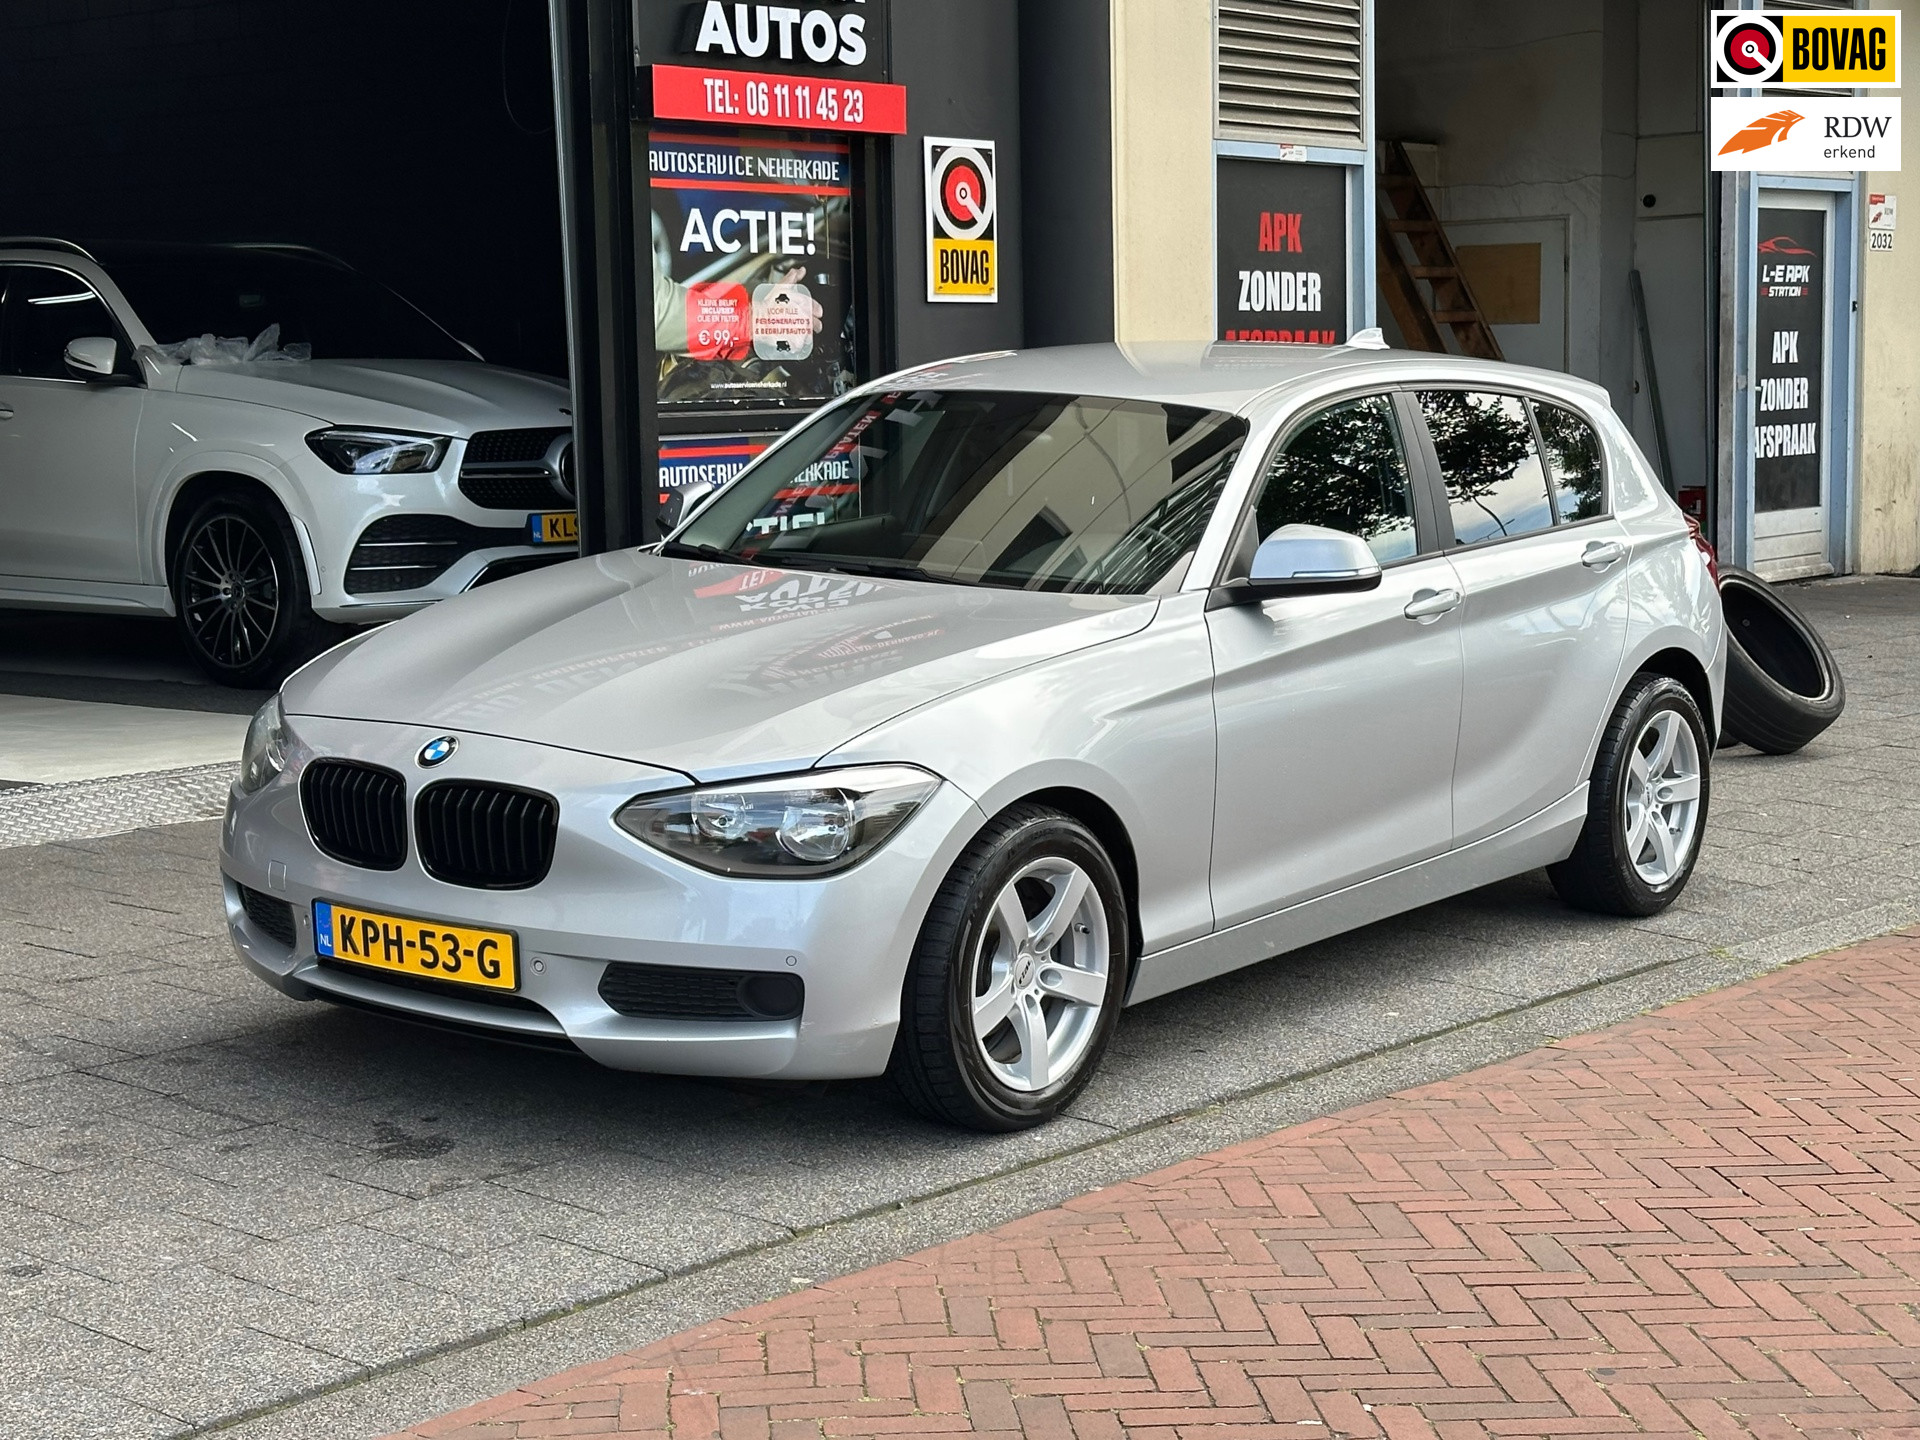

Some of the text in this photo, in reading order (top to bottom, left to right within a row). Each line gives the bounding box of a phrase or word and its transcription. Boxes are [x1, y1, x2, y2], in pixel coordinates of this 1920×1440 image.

[696, 0, 867, 65] AUTOS
[703, 78, 864, 123] TEL: 06 11 11 45 23
[649, 150, 840, 181] AUTOSERVICE NEHERKADE
[680, 207, 816, 256] ACTIE!
[1258, 211, 1303, 253] APK
[1871, 232, 1893, 249] 2032
[940, 249, 990, 285] BOVAG
[1762, 264, 1810, 283] L-E APK
[1238, 270, 1321, 312] ZONDER
[1768, 286, 1802, 297] STATION
[698, 330, 740, 347] € 99,-
[1772, 331, 1798, 363] APK
[1760, 377, 1808, 411] ZONDER
[319, 933, 332, 947] NL
[340, 914, 500, 979] KPH-53-G
